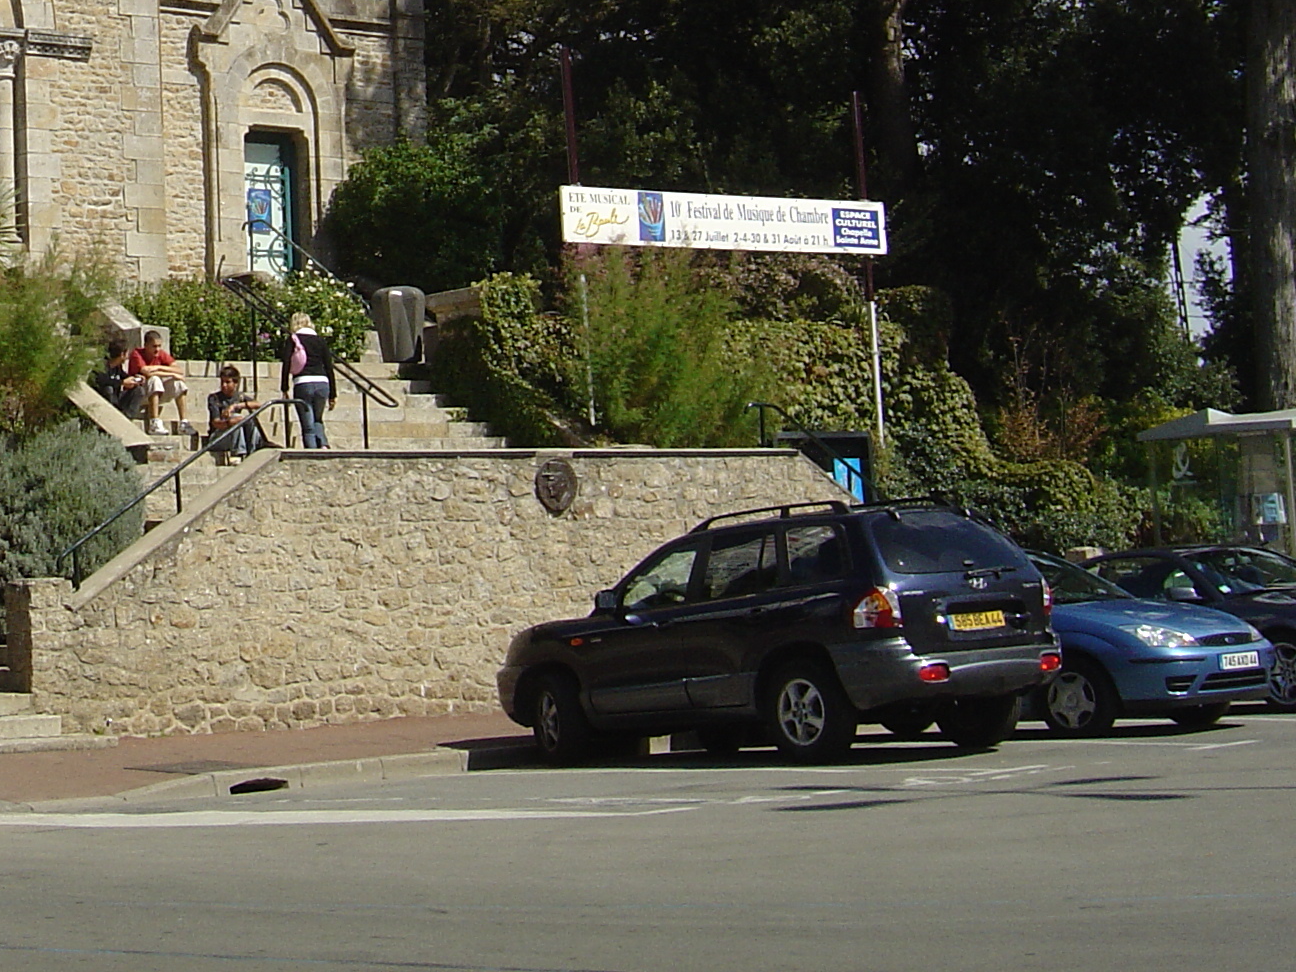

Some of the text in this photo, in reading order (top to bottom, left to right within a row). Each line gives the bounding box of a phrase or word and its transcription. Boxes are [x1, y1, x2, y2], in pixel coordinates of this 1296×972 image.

[589, 193, 630, 205] MUSICAL
[687, 201, 721, 220] Festival
[724, 203, 733, 220] de
[737, 203, 774, 226] Musique
[777, 205, 786, 223] de
[790, 206, 829, 224] Chambre
[840, 210, 871, 219] ESPACE
[835, 218, 877, 228] CULTUREL
[671, 230, 681, 240] 13
[692, 231, 702, 241] 27
[705, 231, 729, 242] Juillet
[772, 233, 780, 244] 31
[811, 235, 820, 245] 21
